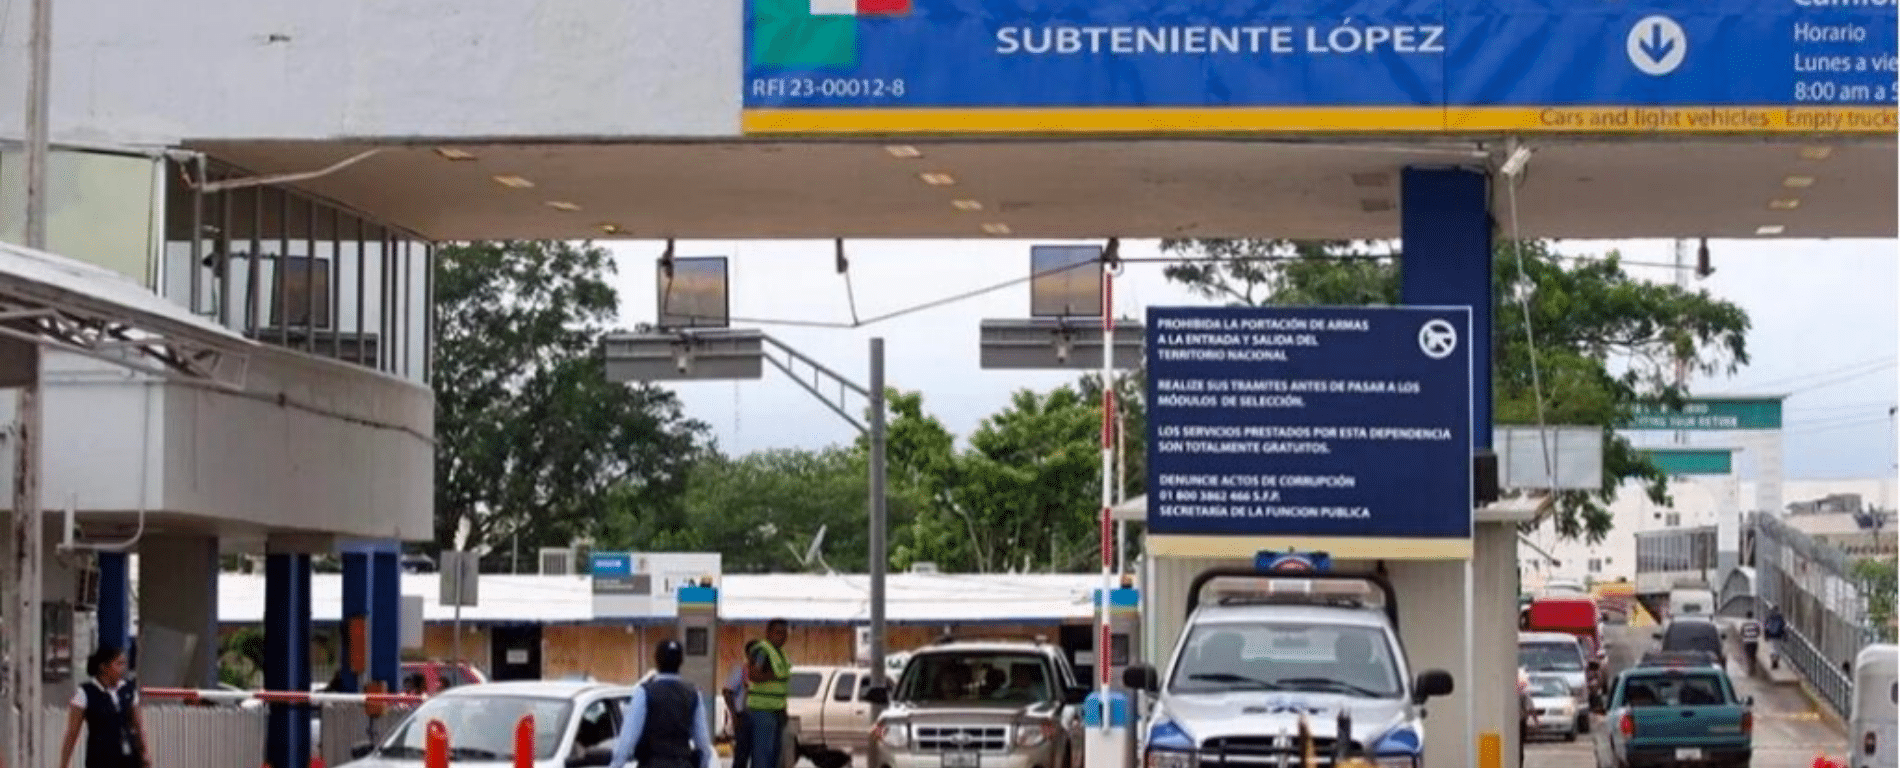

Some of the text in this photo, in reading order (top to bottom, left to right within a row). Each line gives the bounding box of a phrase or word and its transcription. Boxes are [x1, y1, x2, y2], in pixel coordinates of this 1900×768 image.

[996, 16, 1445, 54] SUBTENIENTE LÓPEZ
[1794, 22, 1866, 42] Horario
[1794, 52, 1852, 72] Lunes
[1855, 57, 1868, 72] a
[752, 78, 905, 98] RFI 23-00012-8
[1795, 81, 1836, 101] 8:00
[1839, 86, 1870, 101] am
[1874, 86, 1886, 101] a
[1540, 109, 1770, 130] Cars and light vehicles
[1785, 109, 1844, 130] Empty
[1157, 317, 1370, 332] PROHIBIDA LA PORTACIÓN DE ARMAS
[1157, 334, 1319, 347] A LA ENTRADA Y SALIDA DEL
[1157, 349, 1288, 361] TERRITORIO NACIONAL
[1157, 379, 1421, 394] REALIZE SUS TRAMITES ANTES DE PASAR A LOS
[1157, 393, 1218, 407] MÓDULOS
[1221, 395, 1238, 407] DE
[1157, 425, 1452, 440] LOS SERVICIOS PRESTADOS POR ESTA DEPENDENCIA
[1157, 441, 1331, 455] SON TOTALMENTE GRATUITOS.
[1159, 473, 1356, 488] DENUNCIE ACTOS DE CORRUPCIÓN
[1159, 490, 1174, 502] 01
[1175, 490, 1198, 502] 800
[1159, 503, 1371, 519] SECRETARÍA DE LA FUNCION PUBLICA
